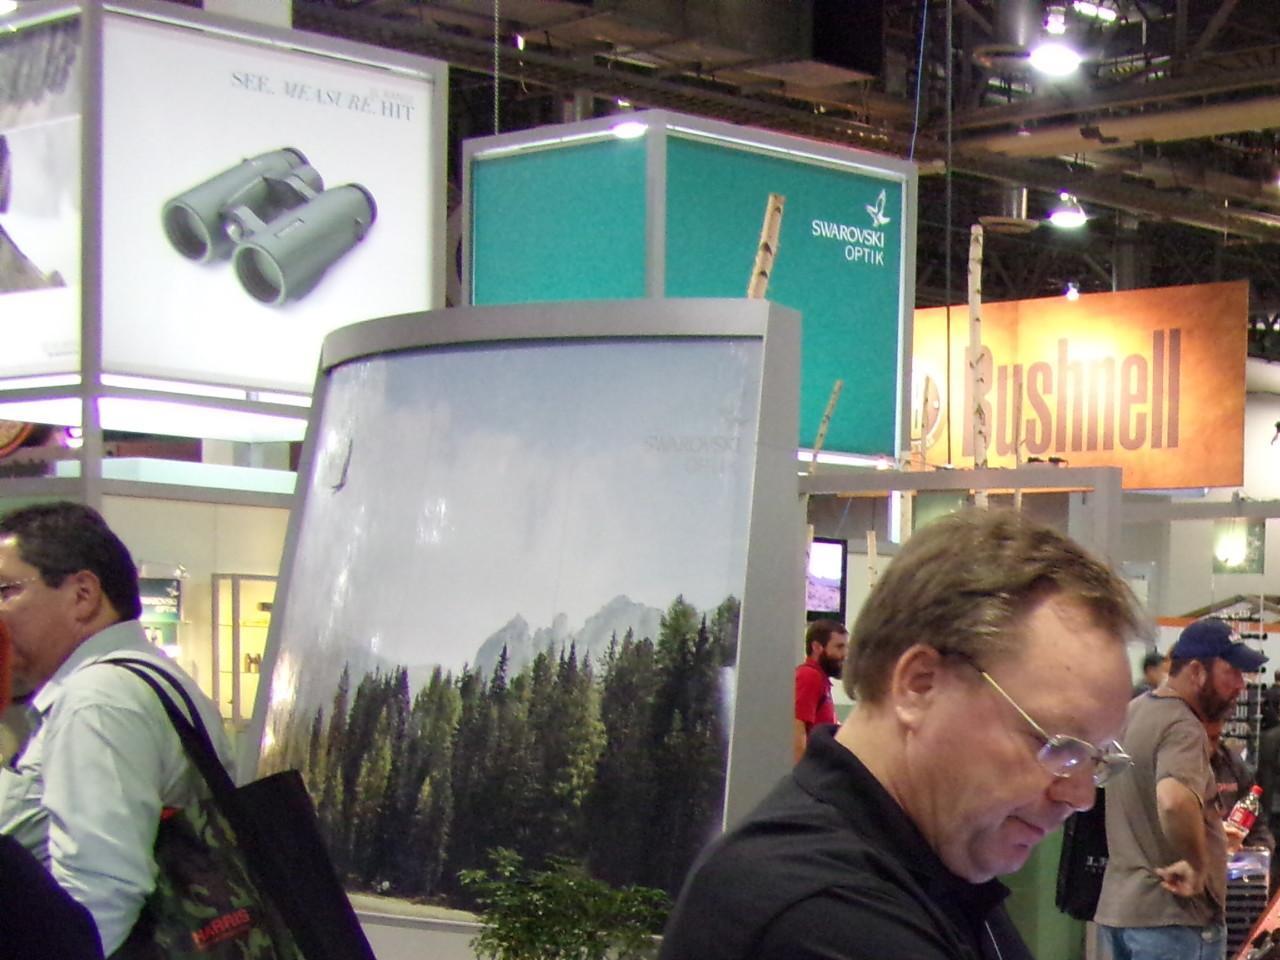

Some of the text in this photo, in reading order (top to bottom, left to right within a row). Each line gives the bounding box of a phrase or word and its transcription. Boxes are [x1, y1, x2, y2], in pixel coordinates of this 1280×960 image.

[381, 100, 415, 121] HIT
[812, 219, 885, 248] SWAROVSKI
[845, 244, 884, 266] OPTIK
[962, 328, 1181, 457] Bushnell
[192, 908, 250, 947] HARRIS
